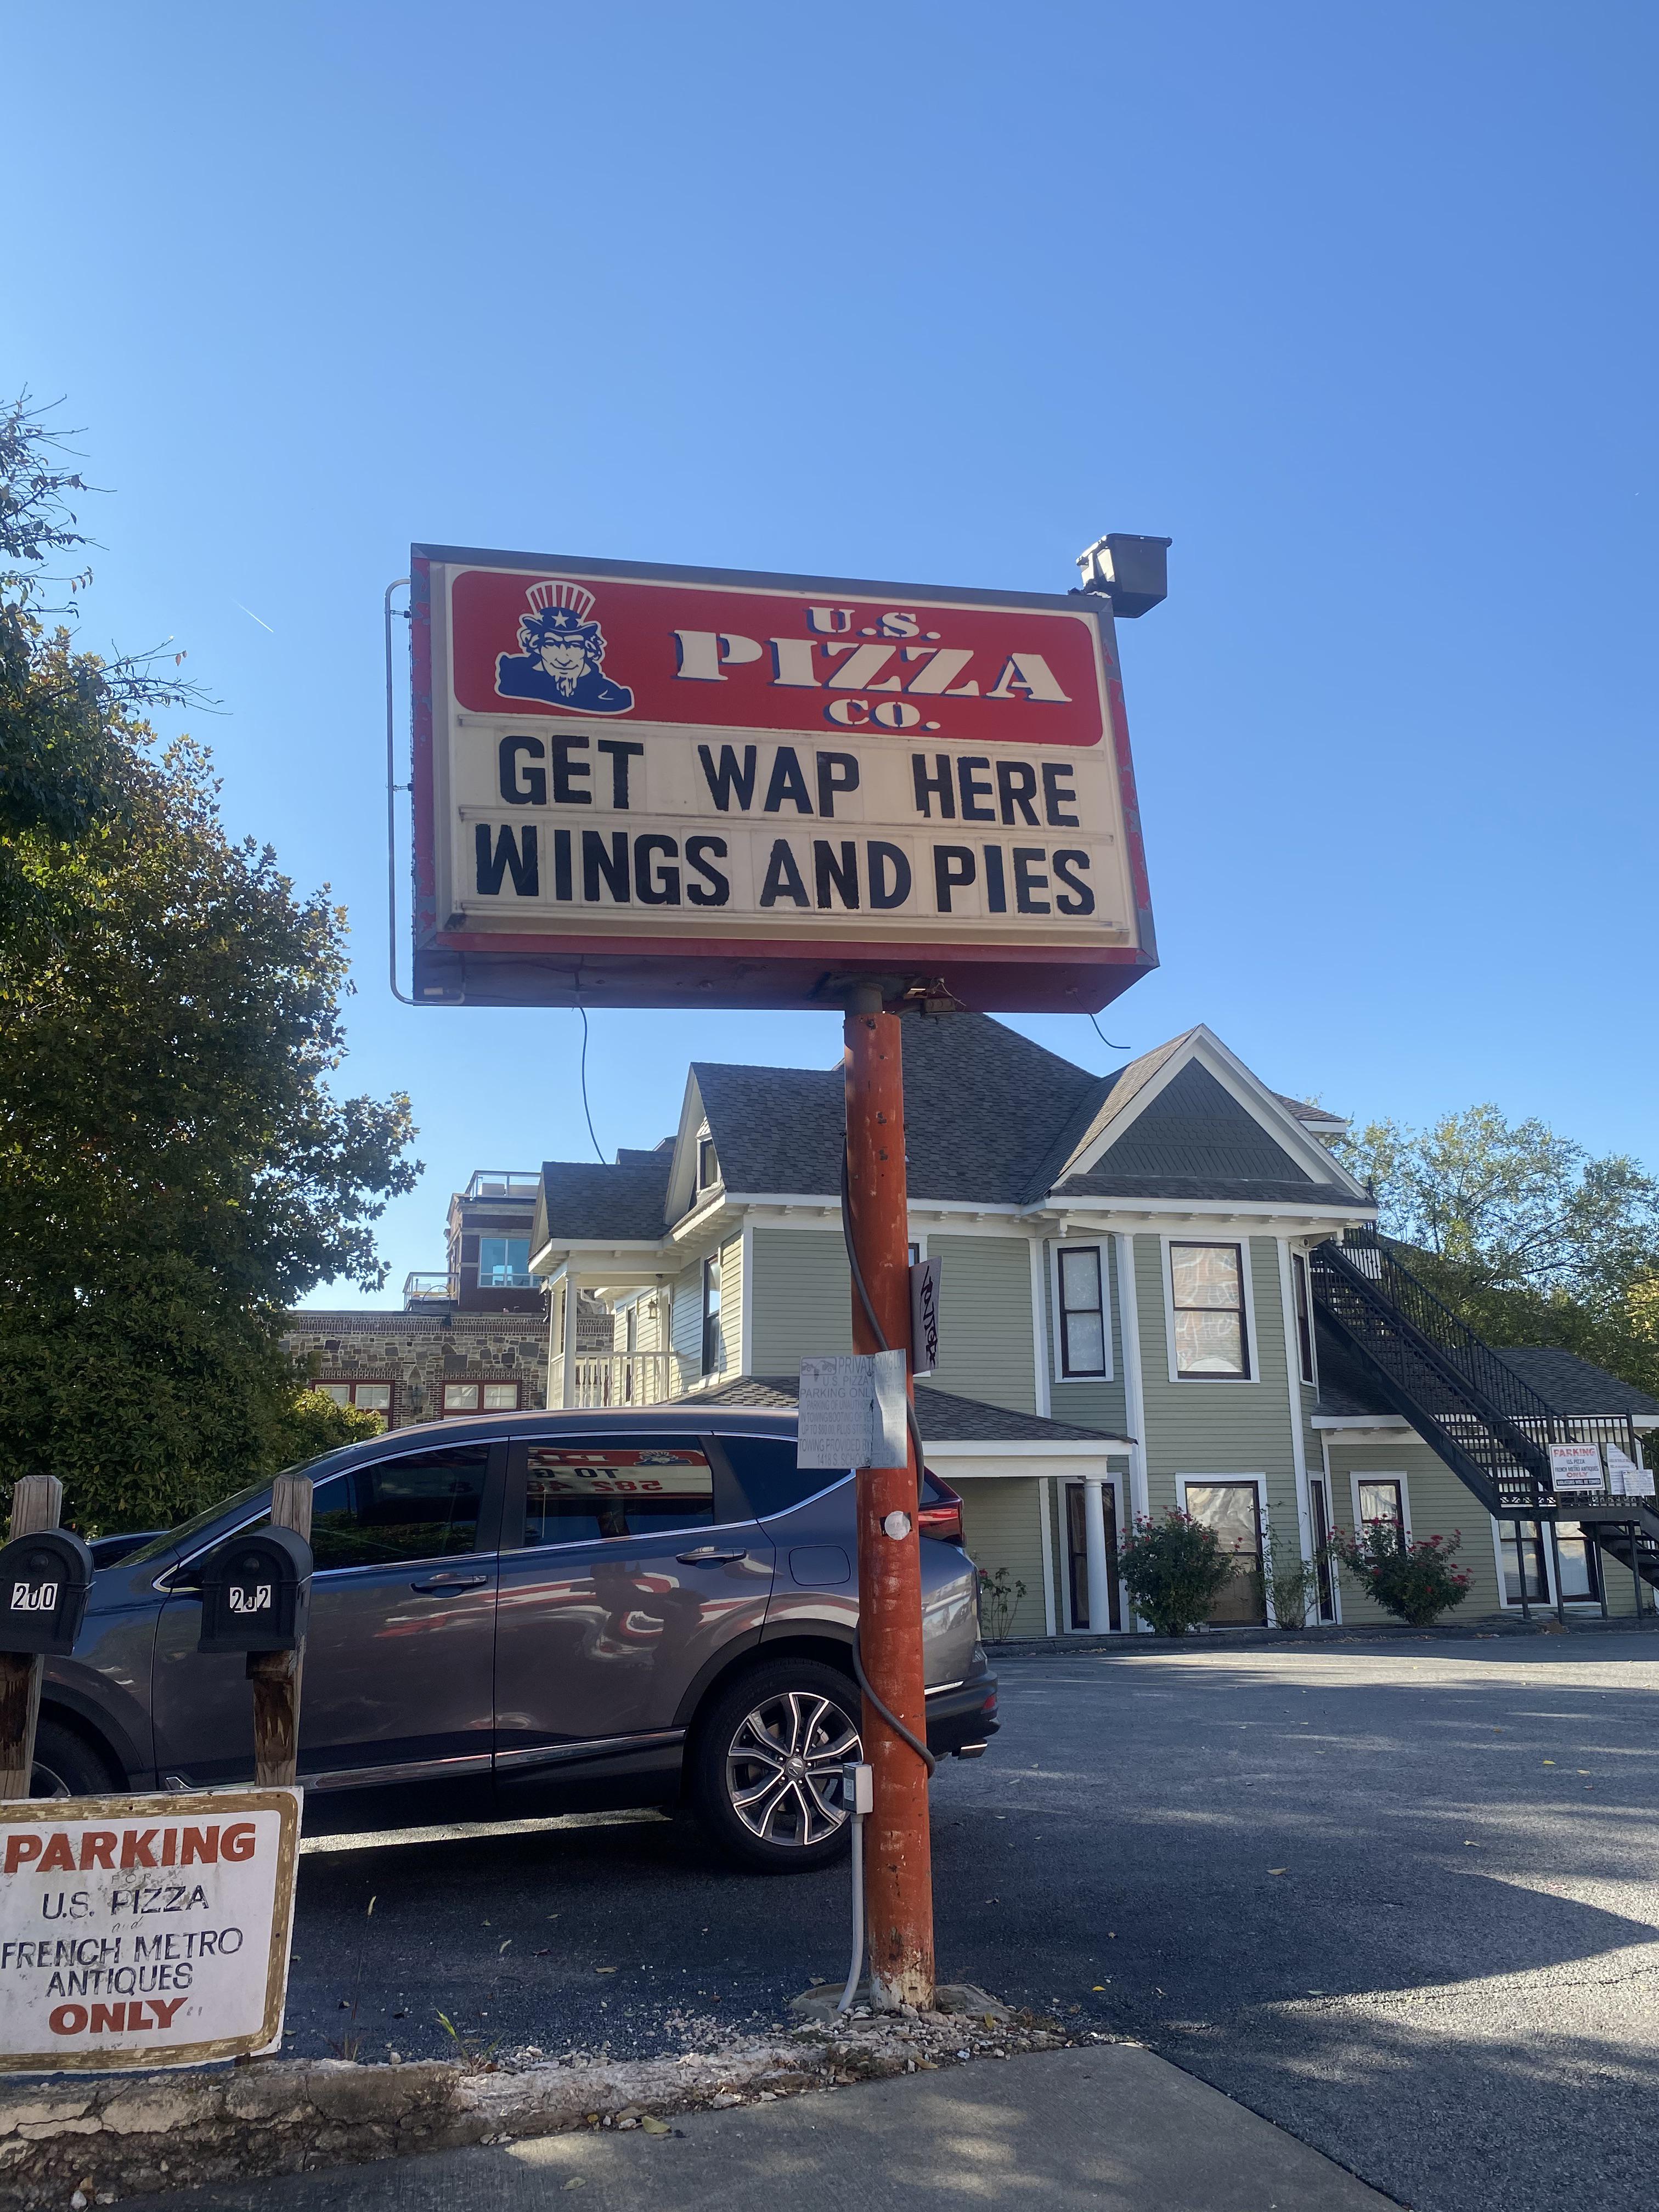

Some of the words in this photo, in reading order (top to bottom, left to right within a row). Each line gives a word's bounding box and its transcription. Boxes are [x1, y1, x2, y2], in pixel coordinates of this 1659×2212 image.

[806, 606, 941, 640] U.S.
[674, 629, 1073, 703] PIZZA
[826, 698, 941, 730] CO.
[499, 735, 644, 810] GET
[697, 744, 860, 818] WAP
[911, 753, 1081, 828] HERE
[475, 823, 731, 907] WINGS
[760, 838, 911, 910] AND
[935, 843, 1095, 915] PIES
[800, 1387, 846, 1398] PARKING
[849, 1387, 876, 1398] ONLY
[843, 1375, 868, 1386] PIZZA
[806, 1412, 828, 1423] TOWING
[807, 1400, 830, 1410] PARKING
[831, 1400, 839, 1410] OF
[798, 1438, 825, 1452] TOWING
[826, 1438, 861, 1452] PROVIDED
[862, 1438, 871, 1452] BY
[802, 1424, 809, 1435] UP
[810, 1424, 817, 1435] TO
[837, 1424, 851, 1435] PLUS
[817, 1453, 832, 1466] 1418
[1553, 1448, 1595, 1458] PARKING
[3, 1822, 256, 1874] PARKING
[111, 1873, 151, 1885] FOR
[42, 1891, 95, 1920] U.S.
[110, 1884, 210, 1916] PIZZA
[1, 1937, 121, 1970] FRENCH
[134, 1927, 244, 1963] METRO
[45, 1962, 193, 1997] ANTIQUES
[48, 1997, 189, 2035] ONLY
